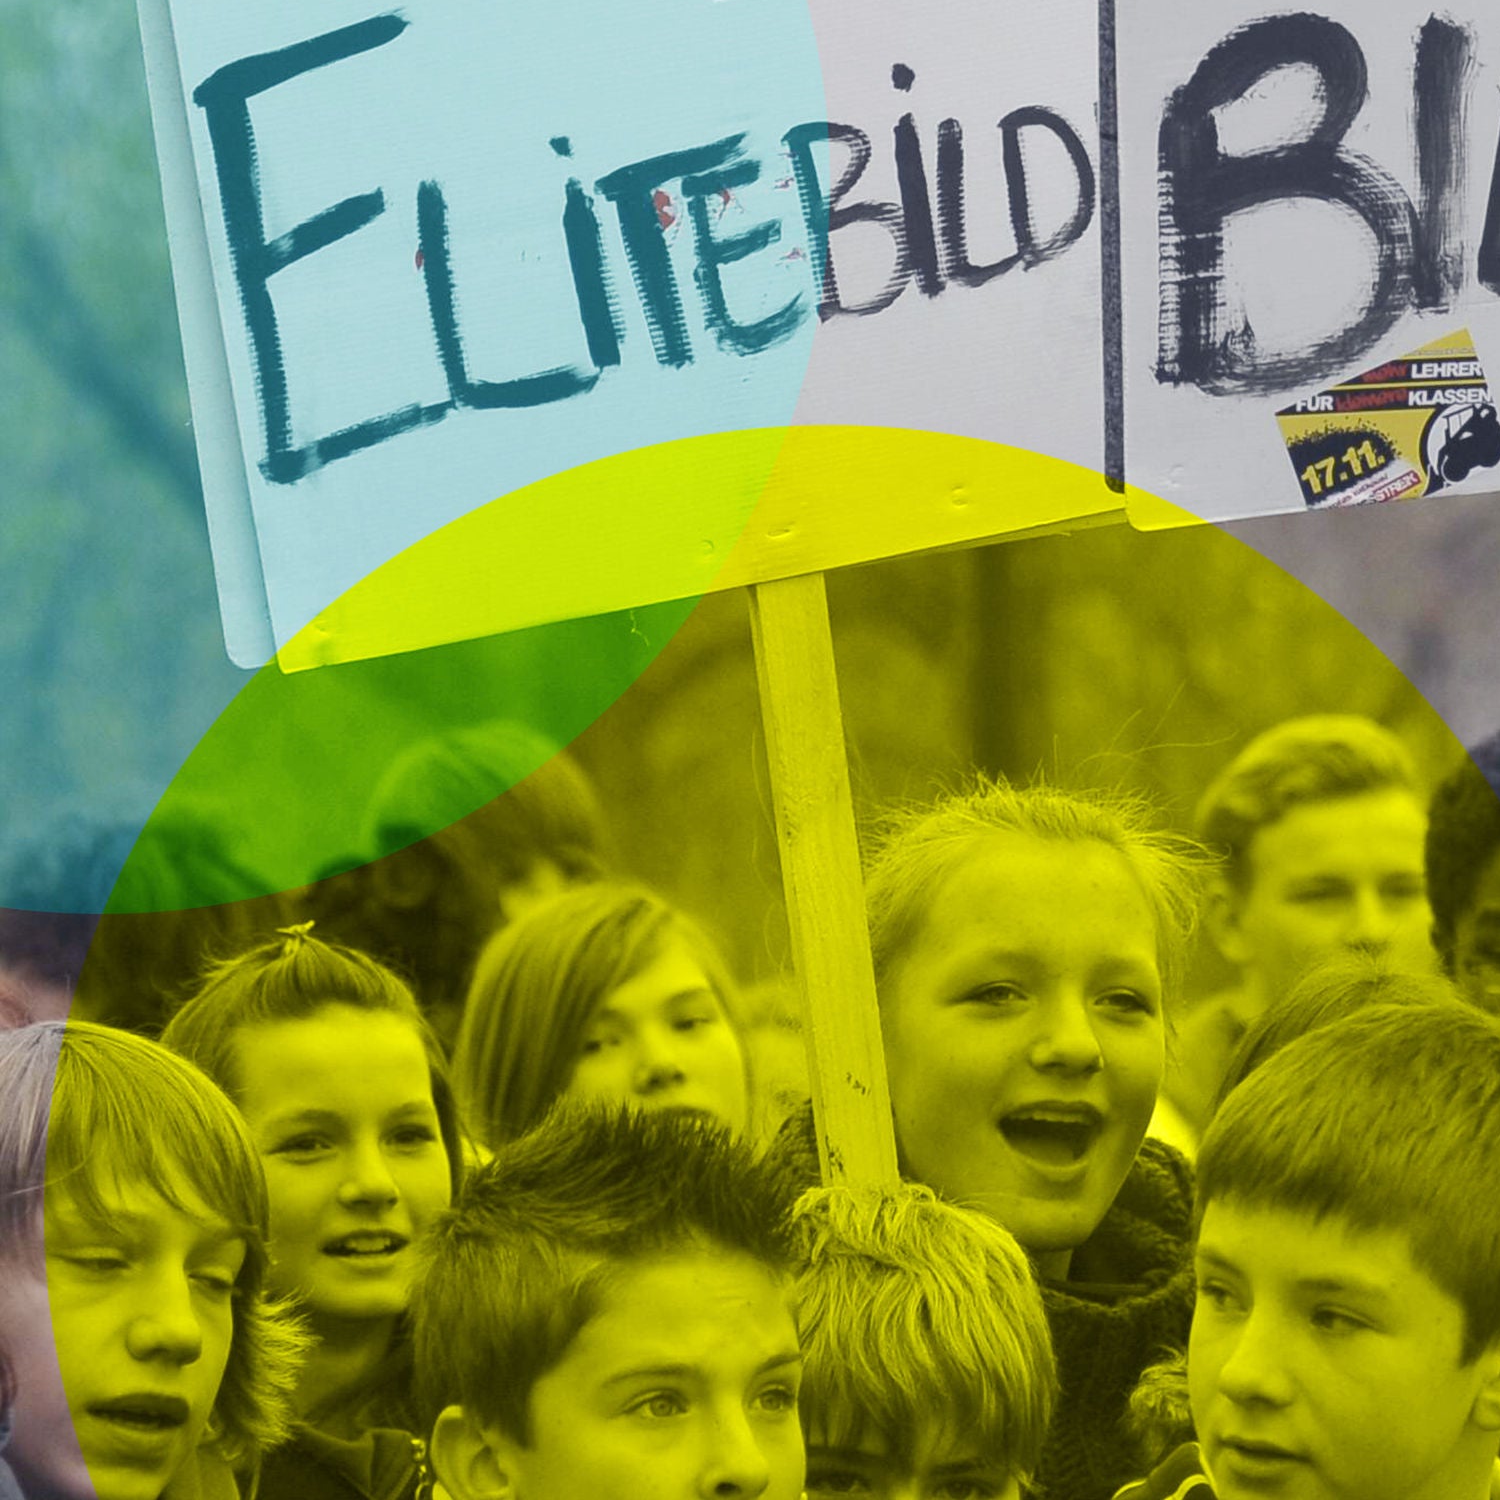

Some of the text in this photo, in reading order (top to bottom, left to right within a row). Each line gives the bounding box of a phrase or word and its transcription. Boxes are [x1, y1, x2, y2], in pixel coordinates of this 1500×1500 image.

[1411, 361, 1484, 380] LEHRER
[1408, 387, 1493, 406] KLASSEN
[1301, 440, 1386, 494] 17.11.
